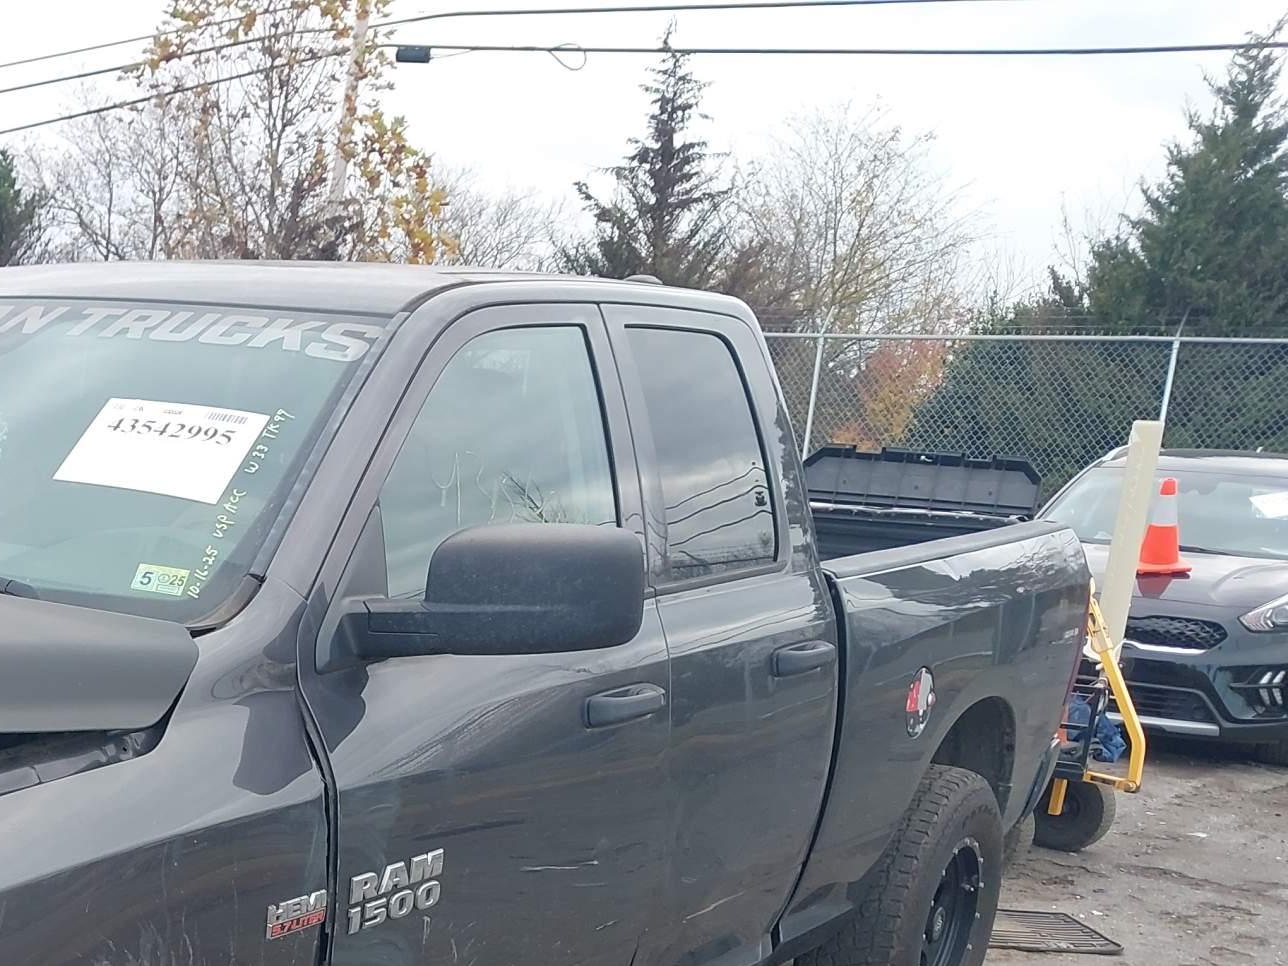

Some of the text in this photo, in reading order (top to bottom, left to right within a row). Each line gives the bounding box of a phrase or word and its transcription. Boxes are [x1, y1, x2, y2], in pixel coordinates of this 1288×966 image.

[65, 307, 386, 362] TRUCKS
[107, 417, 237, 446] 43542995
[139, 571, 186, 586] 5 25
[349, 848, 444, 904] RAM
[267, 889, 327, 923] HEMI
[347, 879, 441, 935] 1500
